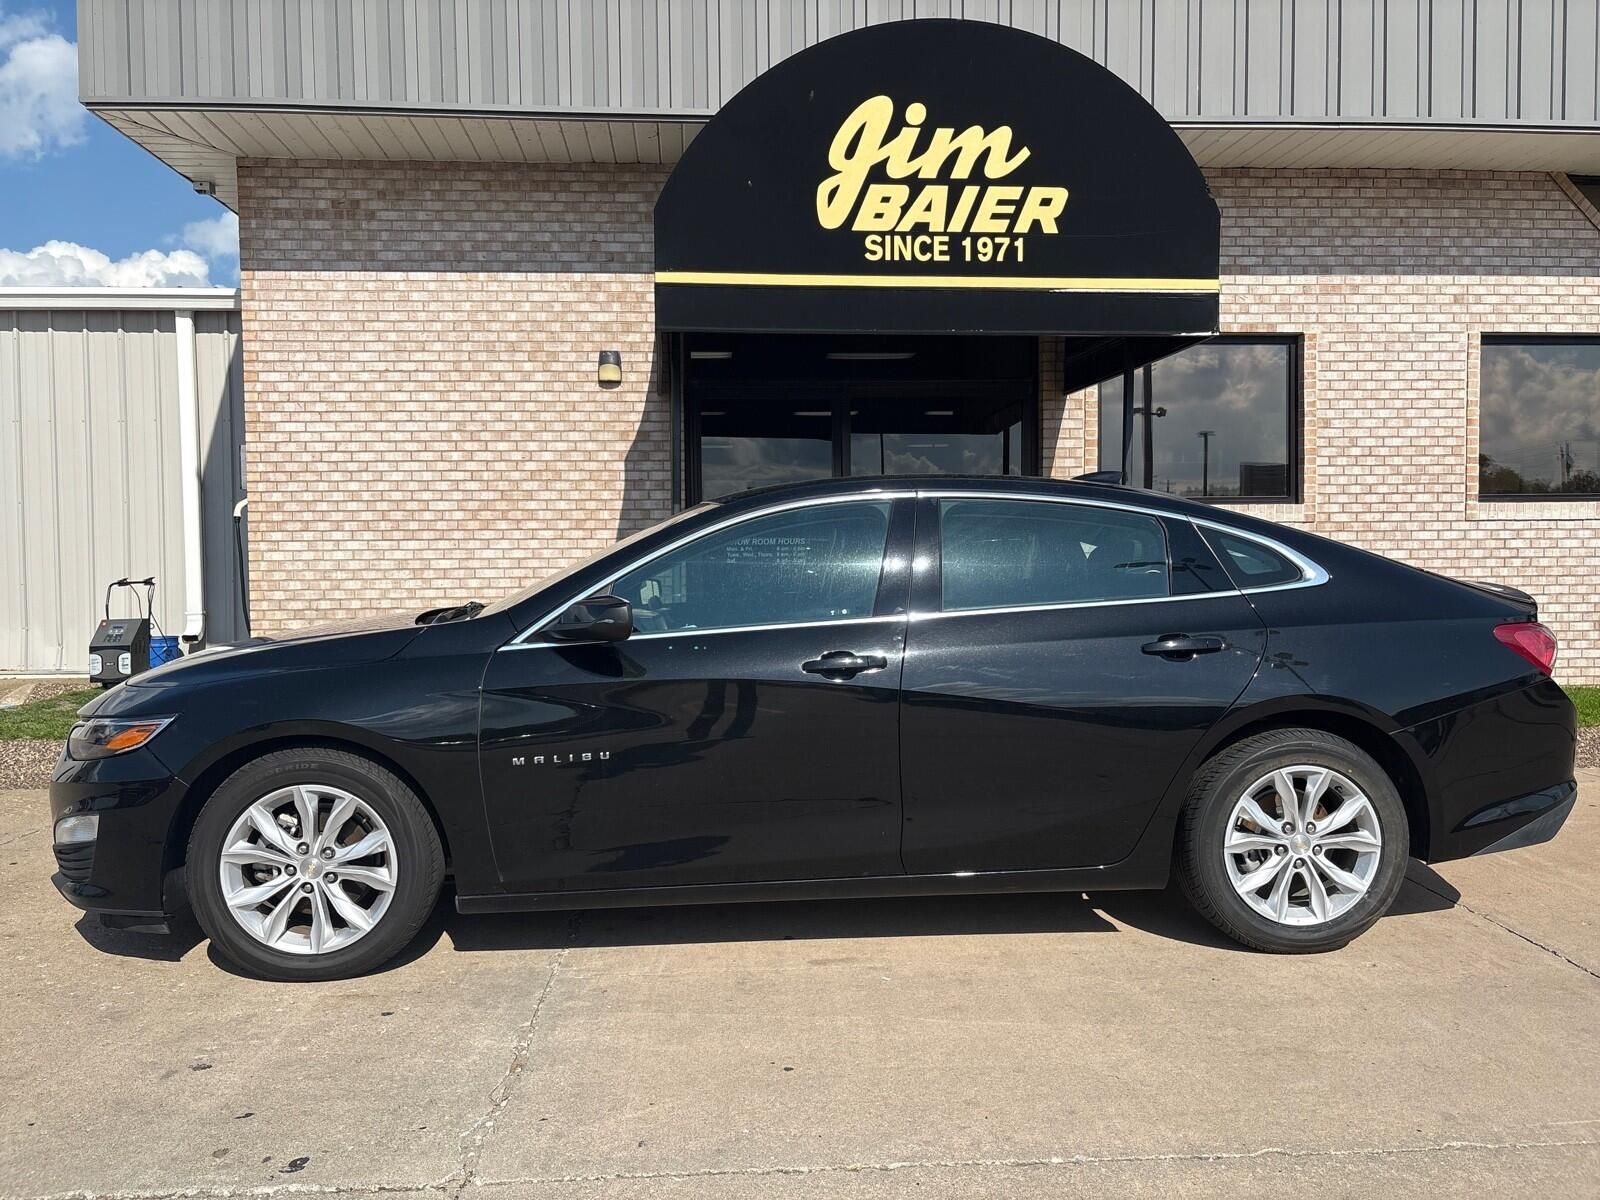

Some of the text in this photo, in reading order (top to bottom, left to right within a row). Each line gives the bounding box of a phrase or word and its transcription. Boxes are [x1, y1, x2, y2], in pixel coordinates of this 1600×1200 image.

[816, 95, 1031, 229] Jim
[851, 184, 1069, 234] BAIER
[864, 235, 1024, 262] SINCE 1971
[512, 751, 610, 766] MALIBU
